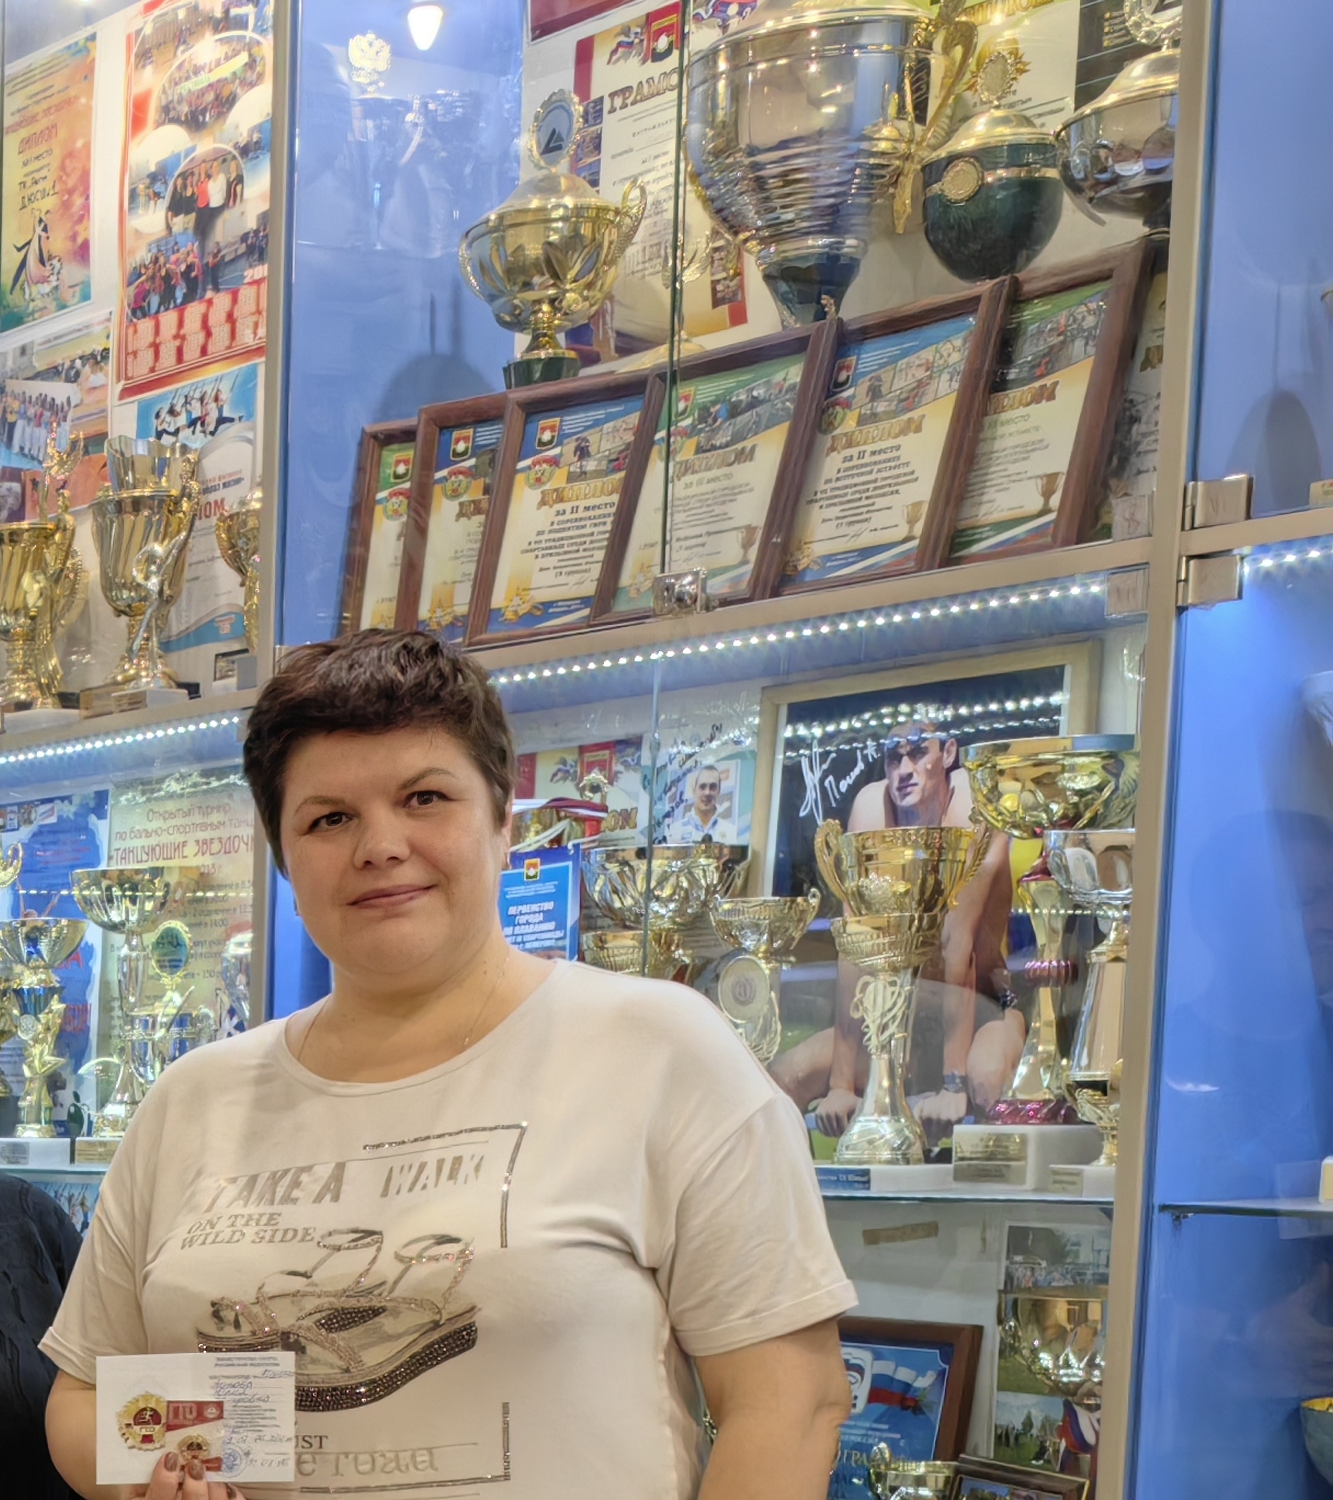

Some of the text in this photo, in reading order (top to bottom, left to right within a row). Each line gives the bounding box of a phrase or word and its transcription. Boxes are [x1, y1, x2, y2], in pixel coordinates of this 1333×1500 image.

[204, 1153, 486, 1214] TAKE A WALK
[186, 1212, 283, 1235] ON THE
[180, 1226, 318, 1251] WILD SIDE
